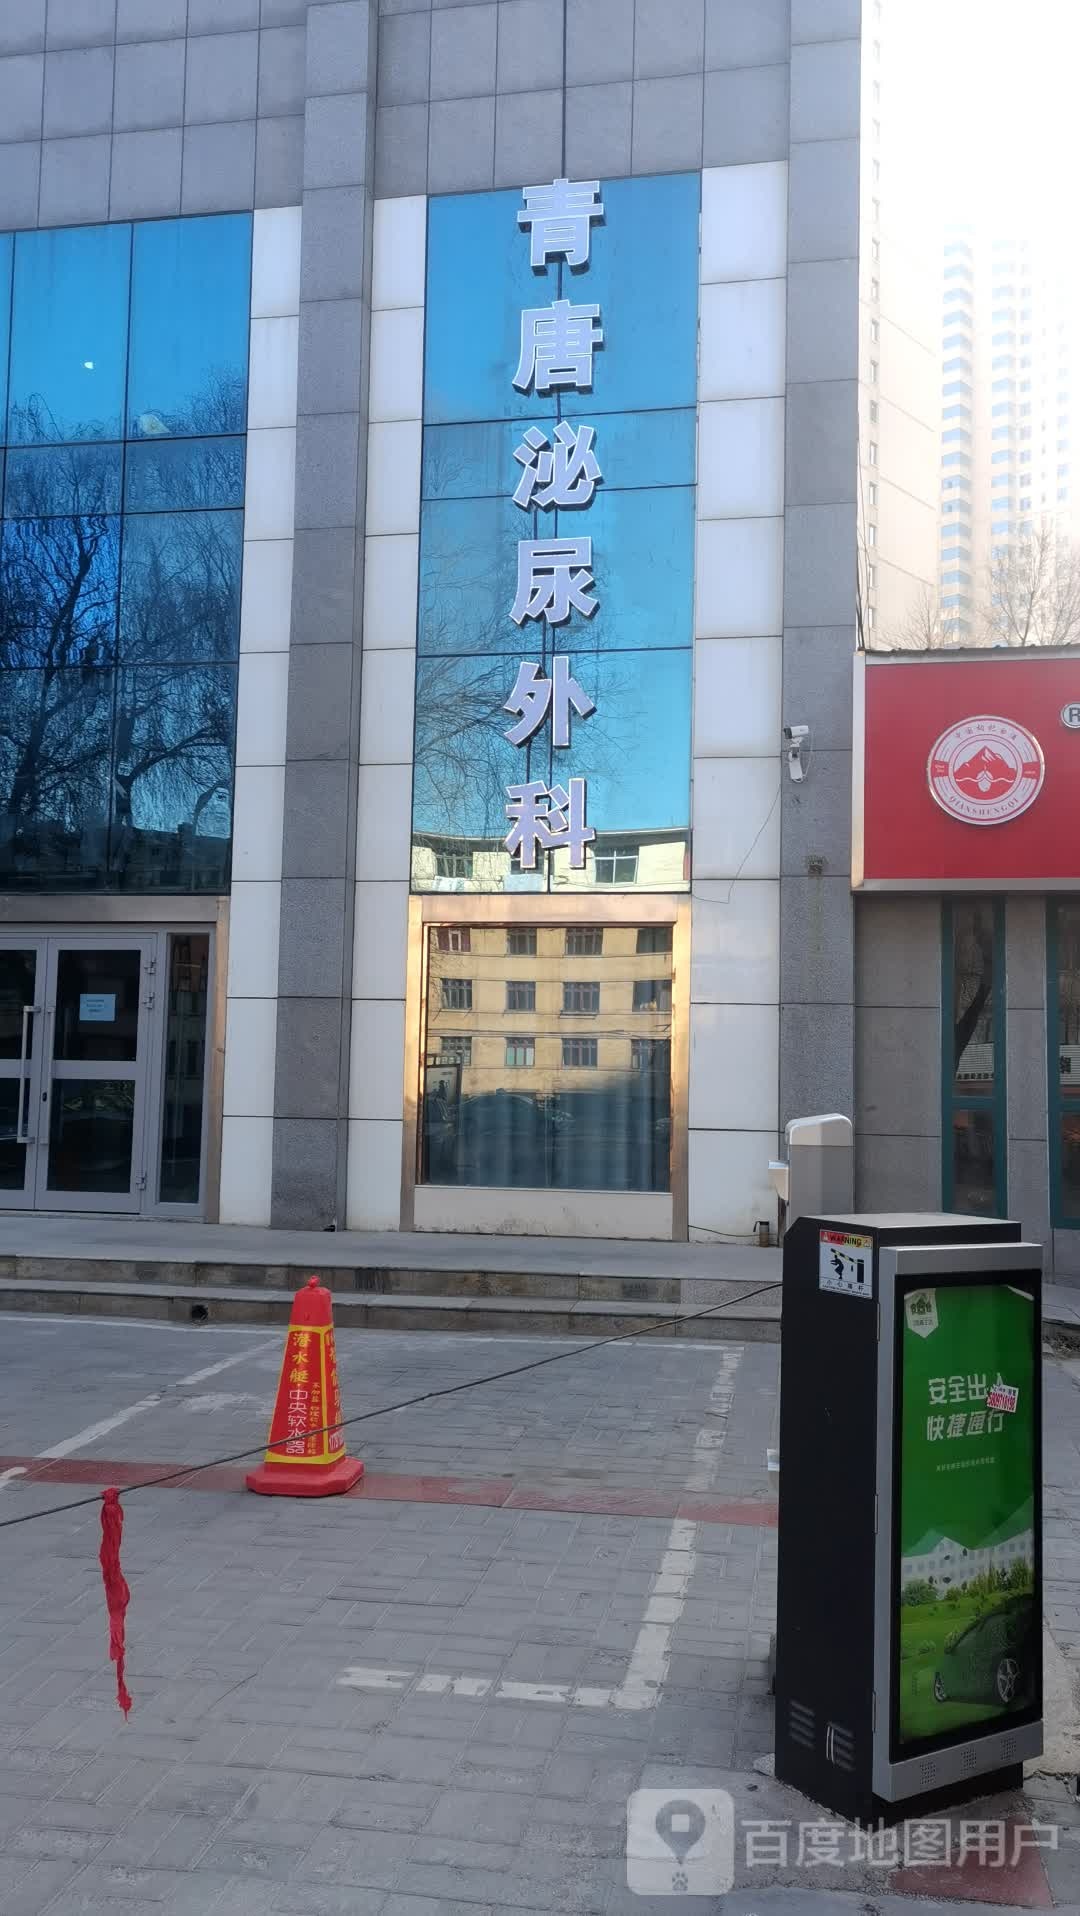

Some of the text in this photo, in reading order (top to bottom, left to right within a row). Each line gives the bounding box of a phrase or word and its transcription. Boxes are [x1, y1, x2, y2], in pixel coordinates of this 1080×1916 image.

[503, 178, 604, 870] 青唐泌尿外科
[830, 1236, 862, 1247] WARNING
[286, 1389, 308, 1454] 中央软水器
[927, 1409, 1004, 1441] 快捷通行
